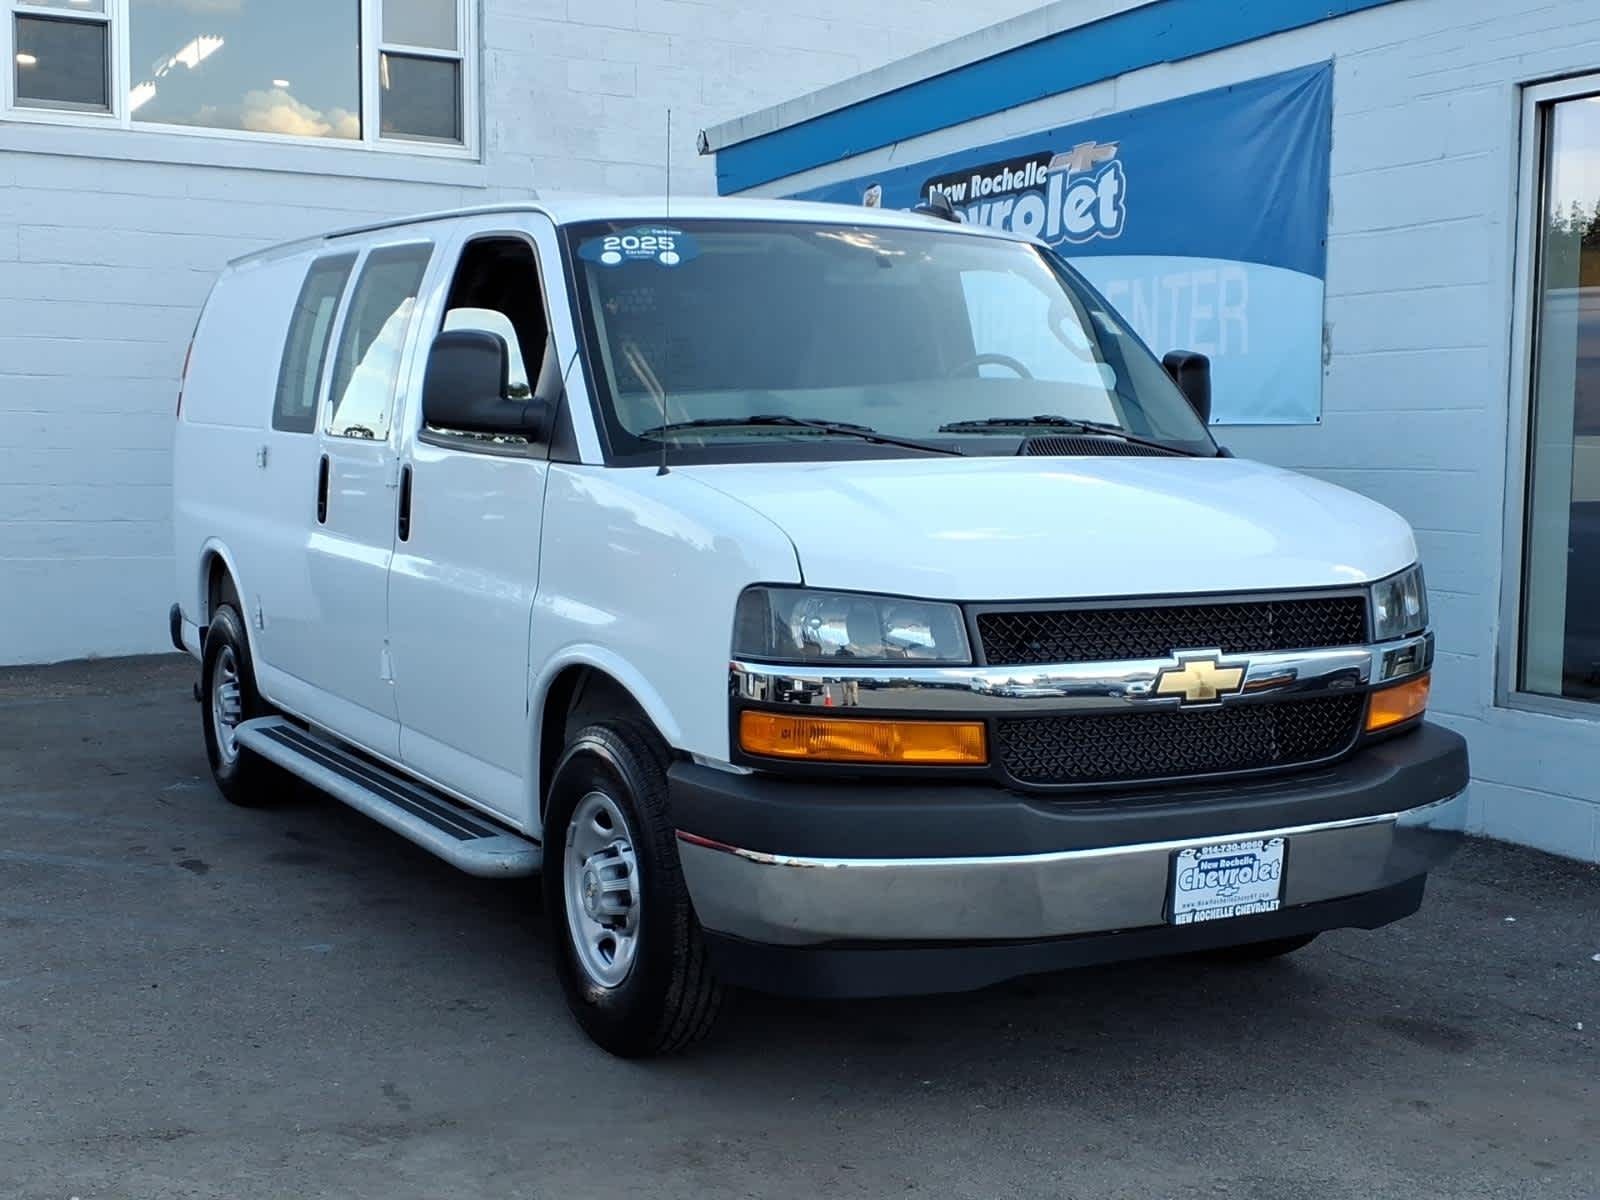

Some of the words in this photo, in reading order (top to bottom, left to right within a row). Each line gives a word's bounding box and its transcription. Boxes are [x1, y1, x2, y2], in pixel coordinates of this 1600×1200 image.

[970, 160, 1049, 198] Rochelle
[603, 235, 676, 251] 2025
[1179, 858, 1281, 891] Chevrolet
[1200, 860, 1219, 870] New
[1220, 856, 1254, 868] Rochelle
[1175, 911, 1194, 925] NEW
[1194, 905, 1235, 922] ROCHELLE
[1235, 900, 1281, 917] CHEVROLET
